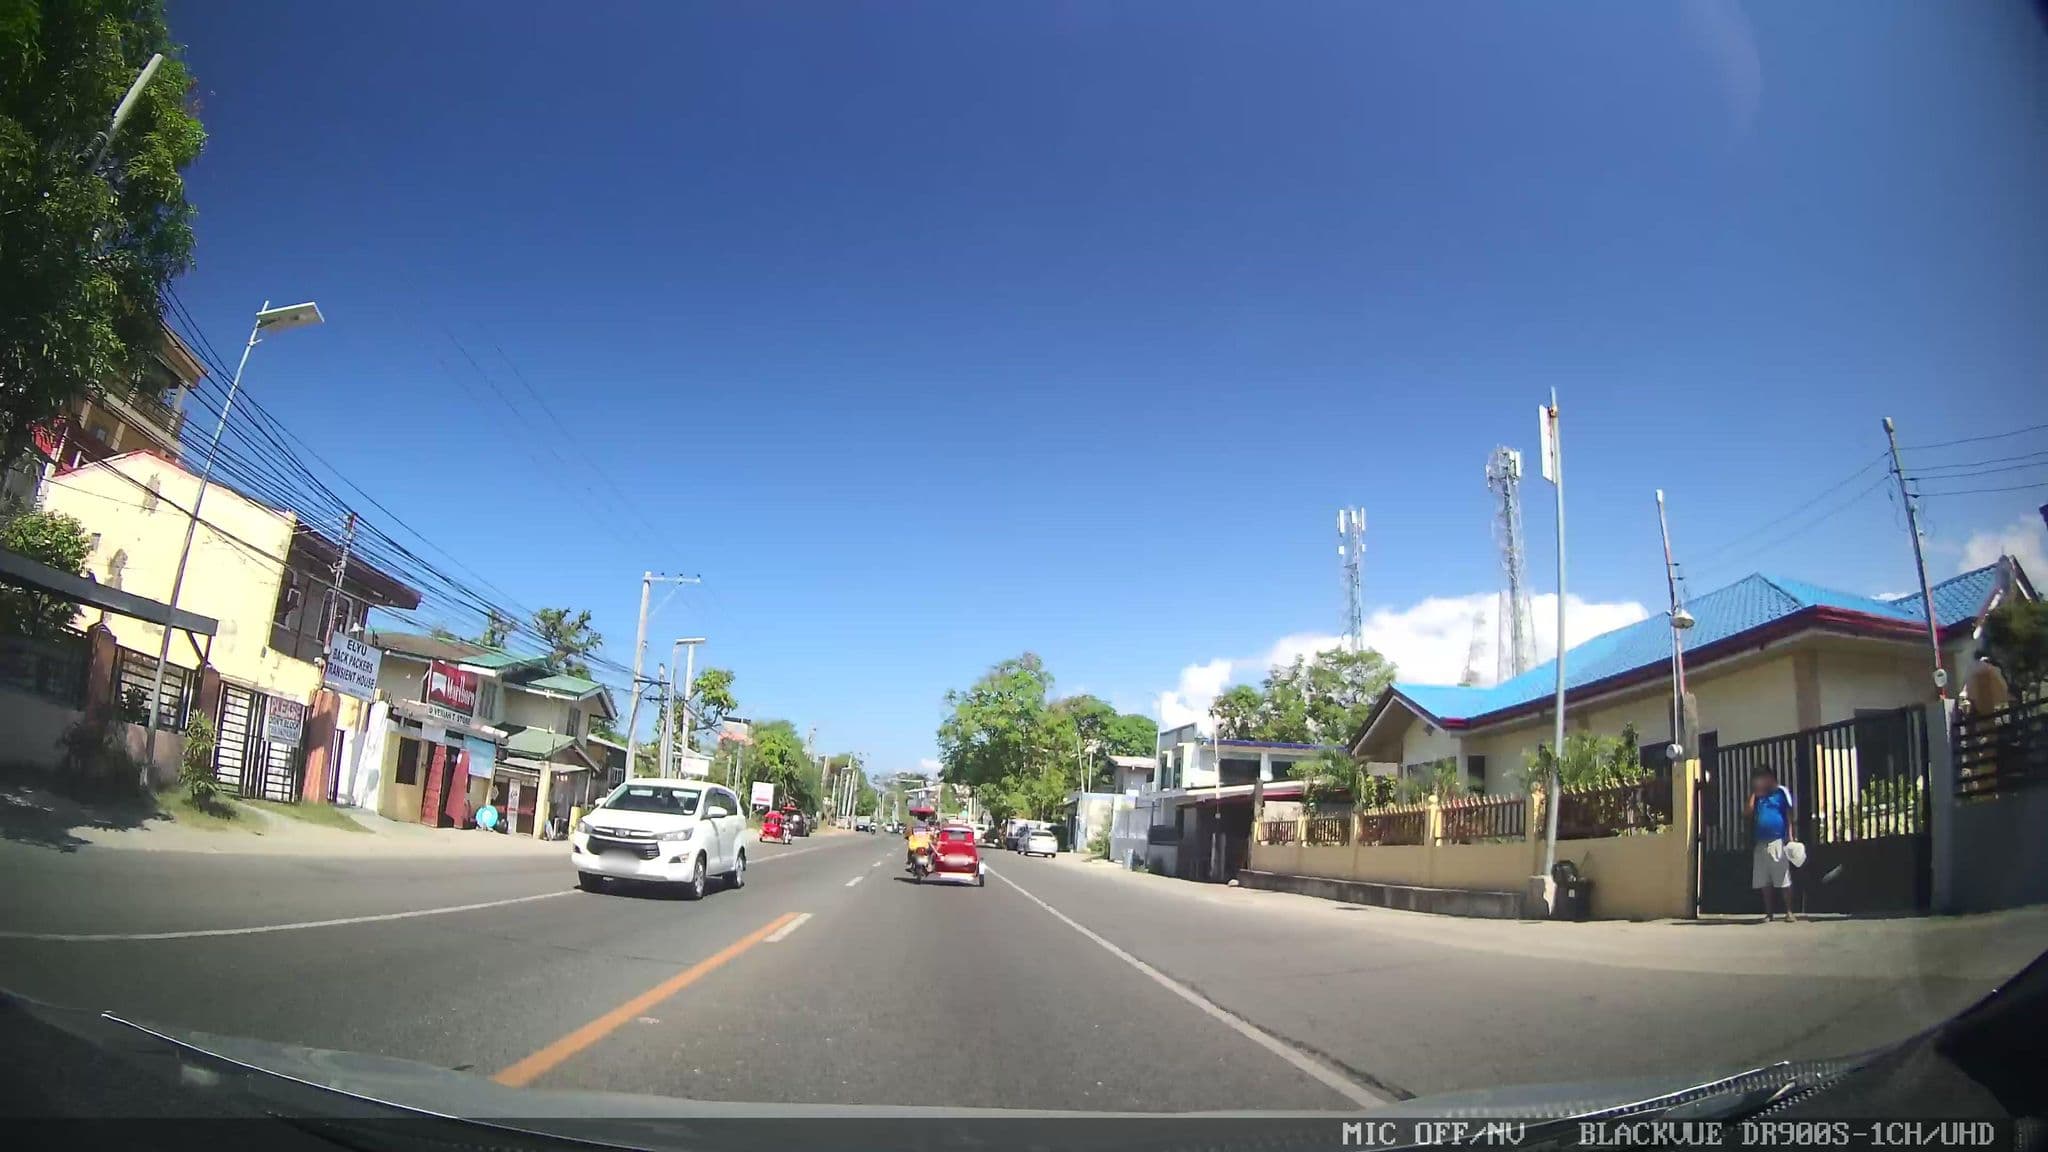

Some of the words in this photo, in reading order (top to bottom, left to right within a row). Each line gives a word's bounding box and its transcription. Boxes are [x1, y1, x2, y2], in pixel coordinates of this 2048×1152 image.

[347, 640, 367, 656] ELYU
[333, 648, 349, 664] BACK
[348, 656, 374, 674] PACKERS
[356, 674, 375, 690] HOUSE
[447, 674, 475, 706] Marlboro
